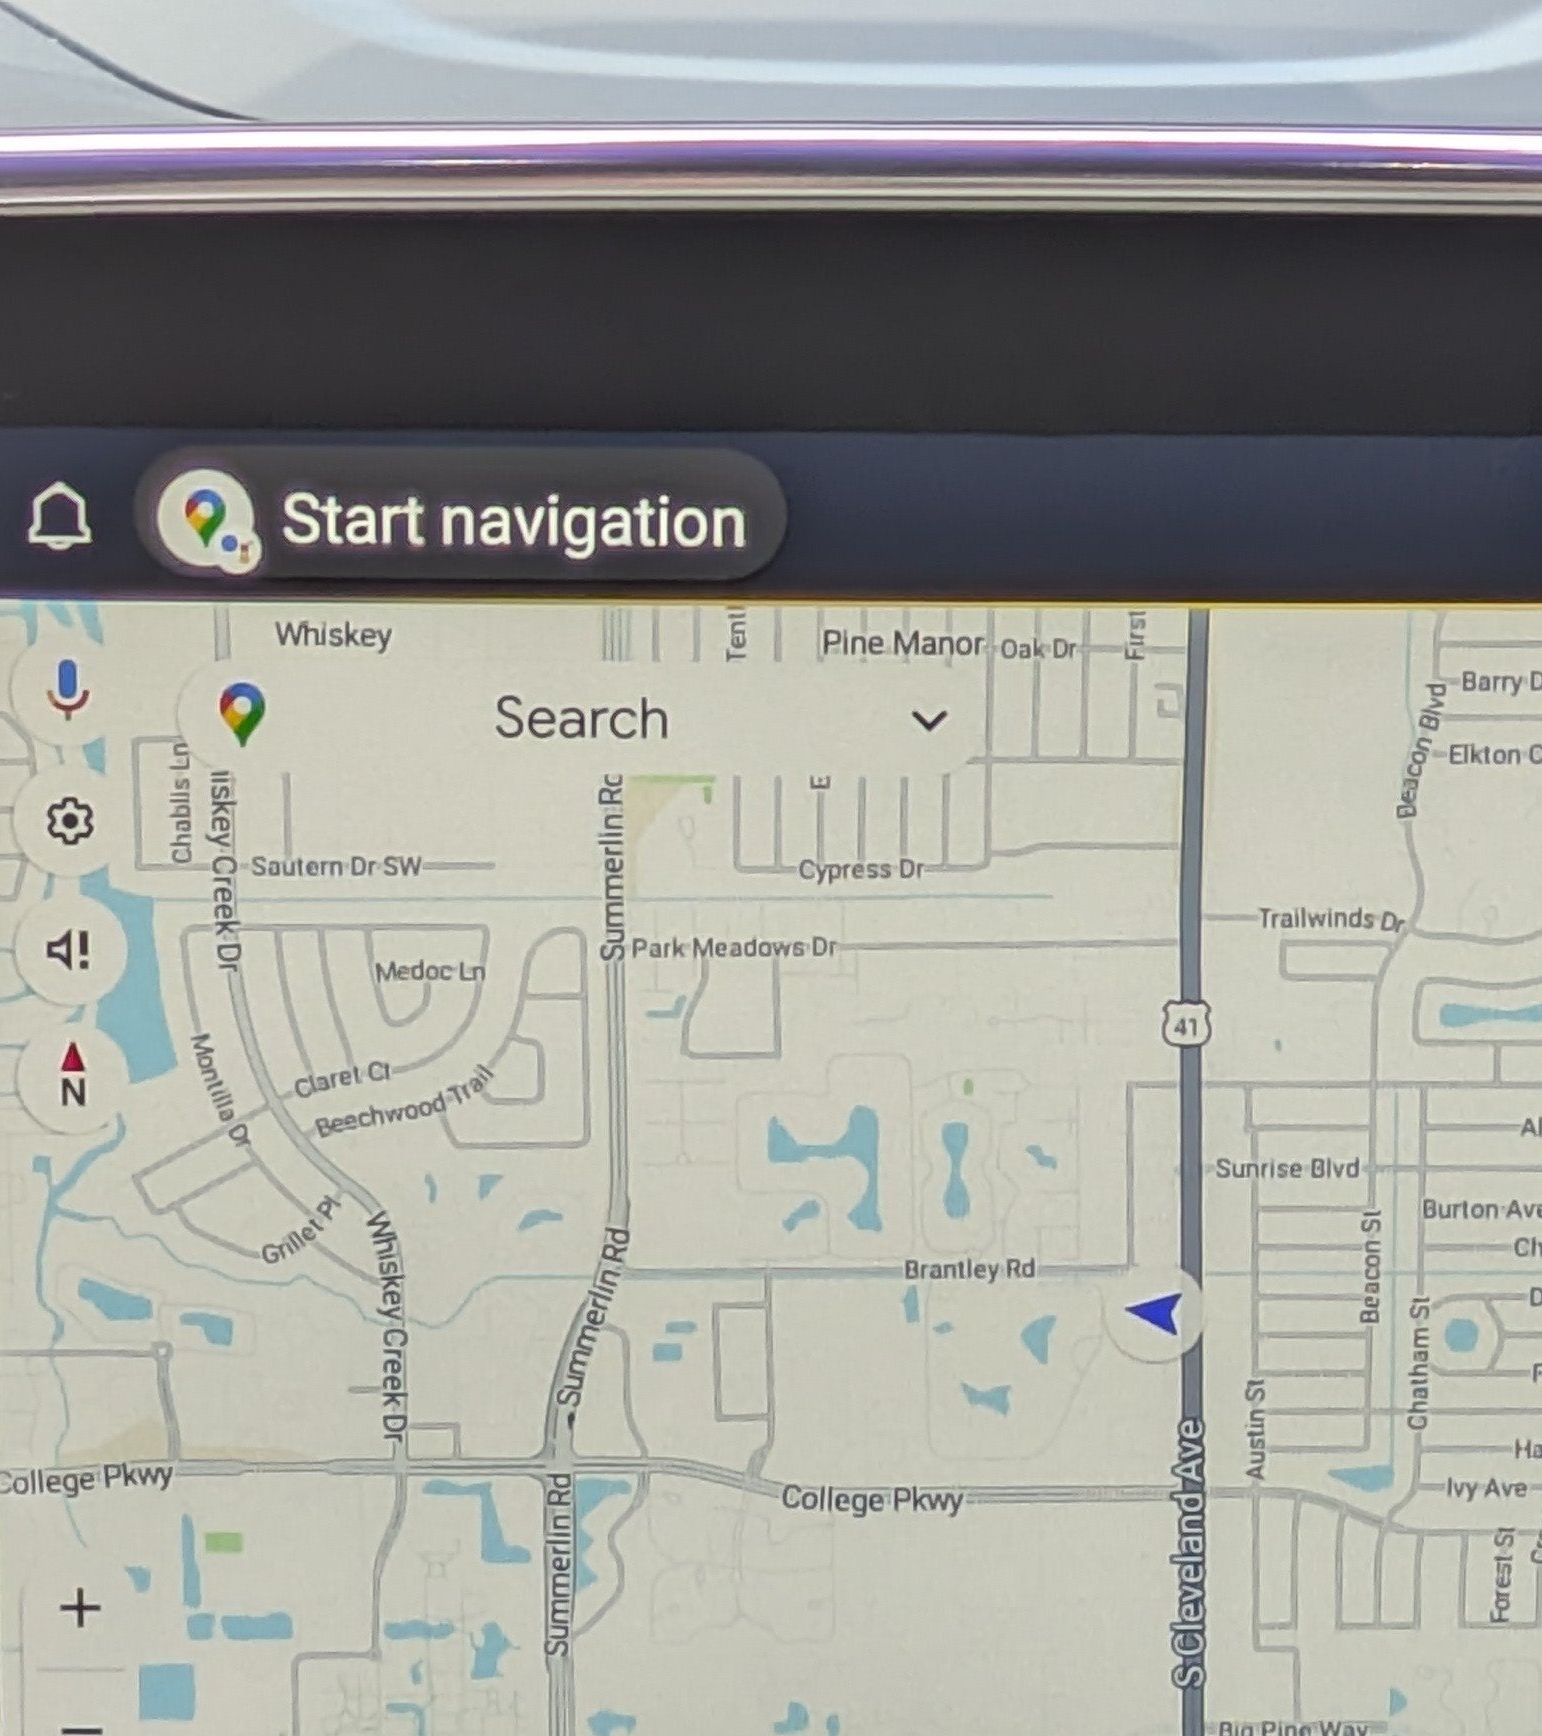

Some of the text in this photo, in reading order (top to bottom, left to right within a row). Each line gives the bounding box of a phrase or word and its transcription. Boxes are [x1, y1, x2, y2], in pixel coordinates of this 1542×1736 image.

[282, 492, 747, 560] Start navigation
[275, 620, 392, 654] Whiskey
[822, 629, 984, 657] Pine Manor
[1000, 638, 1077, 660] Oak Dr
[1462, 671, 1522, 696] Barry
[495, 695, 669, 740] Search
[1420, 683, 1447, 732] Blvd
[1449, 744, 1521, 765] Elkton
[169, 743, 192, 864] Chablis Ln
[251, 857, 422, 877] Sautern Dr SW
[799, 859, 925, 885] Cypress Dr
[212, 856, 241, 935] Creek
[599, 814, 625, 961] Summerlin
[1260, 908, 1405, 933] Trailwinds Dr
[217, 943, 242, 972] Dr
[631, 936, 837, 959] Park Meadows Dr
[375, 961, 486, 983] Medoc Ln
[1174, 1018, 1197, 1037] 41
[61, 1077, 85, 1106] N
[191, 1034, 251, 1147] Montilla Dr
[294, 1066, 362, 1099] Claret
[315, 1064, 495, 1139] Beechwood Trail
[1216, 1157, 1360, 1179] Sunrise Blvd
[1423, 1199, 1500, 1220] Burton
[262, 1195, 342, 1265] Grillet Pl
[904, 1258, 1035, 1283] Brantley Rd
[1361, 1209, 1382, 1324] Beacon St
[366, 1210, 409, 1443] Whiskey Creek Dr
[556, 1227, 630, 1408] Summerlin Rd
[1407, 1296, 1430, 1430] Chatham St
[1245, 1379, 1266, 1481] Austin St
[103, 1461, 174, 1492] Pkwy
[1446, 1477, 1528, 1500] Ivy Ave
[781, 1483, 965, 1518] College Pkwy
[544, 1473, 572, 1657] Summerlin Rd
[1170, 1418, 1205, 1689] S Cleveland Ave
[1490, 1526, 1516, 1624] Forest St
